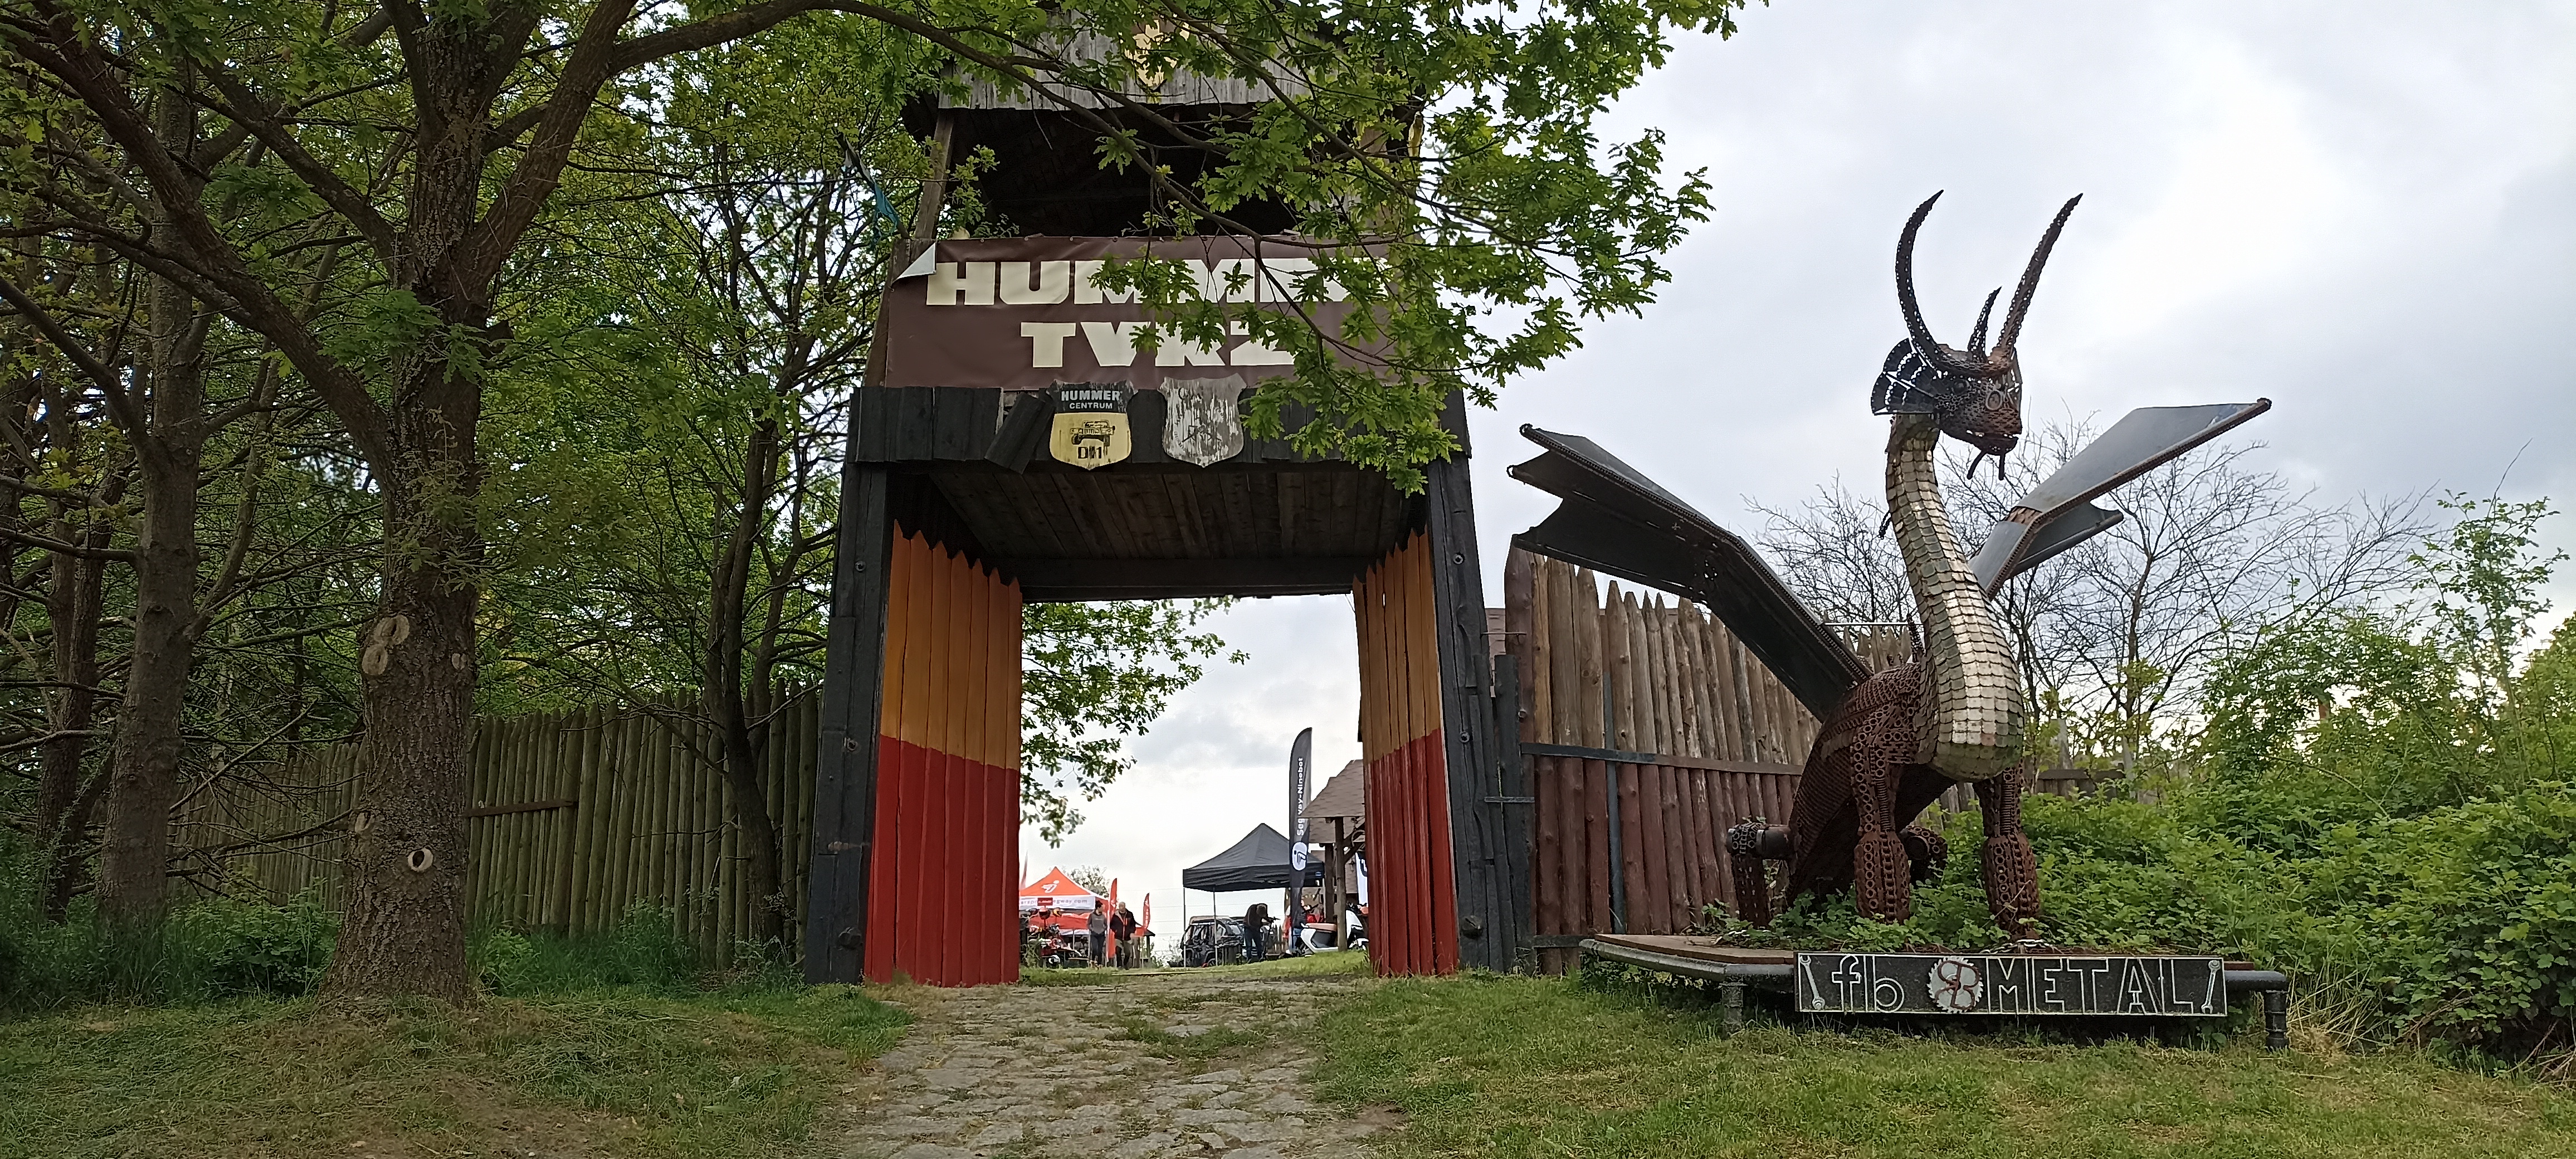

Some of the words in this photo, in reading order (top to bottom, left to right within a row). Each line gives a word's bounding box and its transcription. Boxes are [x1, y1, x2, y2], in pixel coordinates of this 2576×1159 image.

[926, 257, 1391, 305] HUMME
[1061, 390, 1120, 401] HUMMER
[1986, 957, 2194, 1016] METAL
